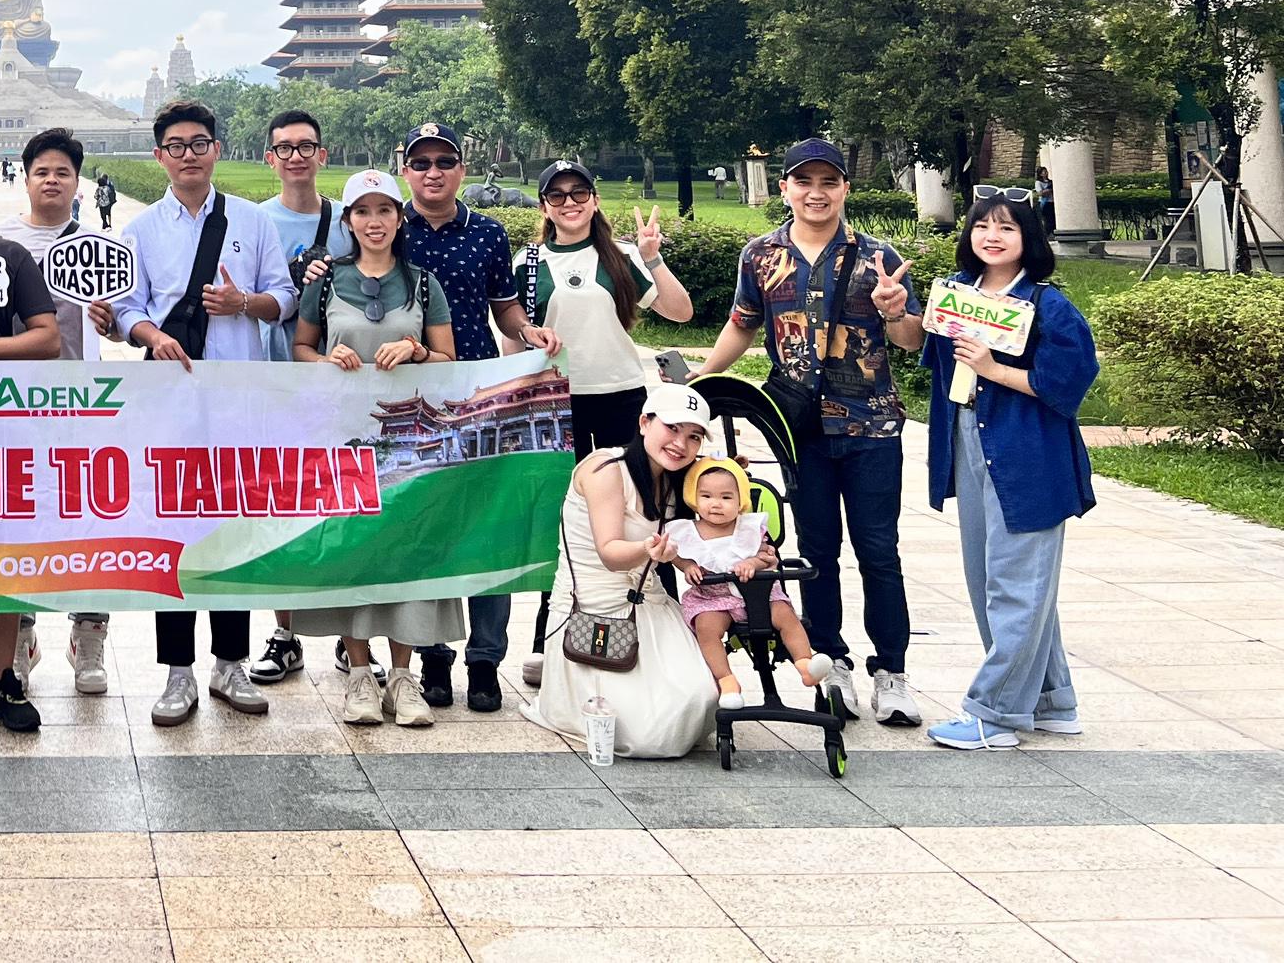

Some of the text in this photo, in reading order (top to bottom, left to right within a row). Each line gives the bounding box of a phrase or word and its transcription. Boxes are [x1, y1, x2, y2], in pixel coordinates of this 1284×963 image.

[53, 240, 128, 268] COOLER
[53, 268, 129, 297] MASTER
[28, 409, 80, 417] TRAVEL
[686, 394, 698, 411] B
[49, 445, 130, 520] TO
[145, 445, 382, 518] TAIWAN
